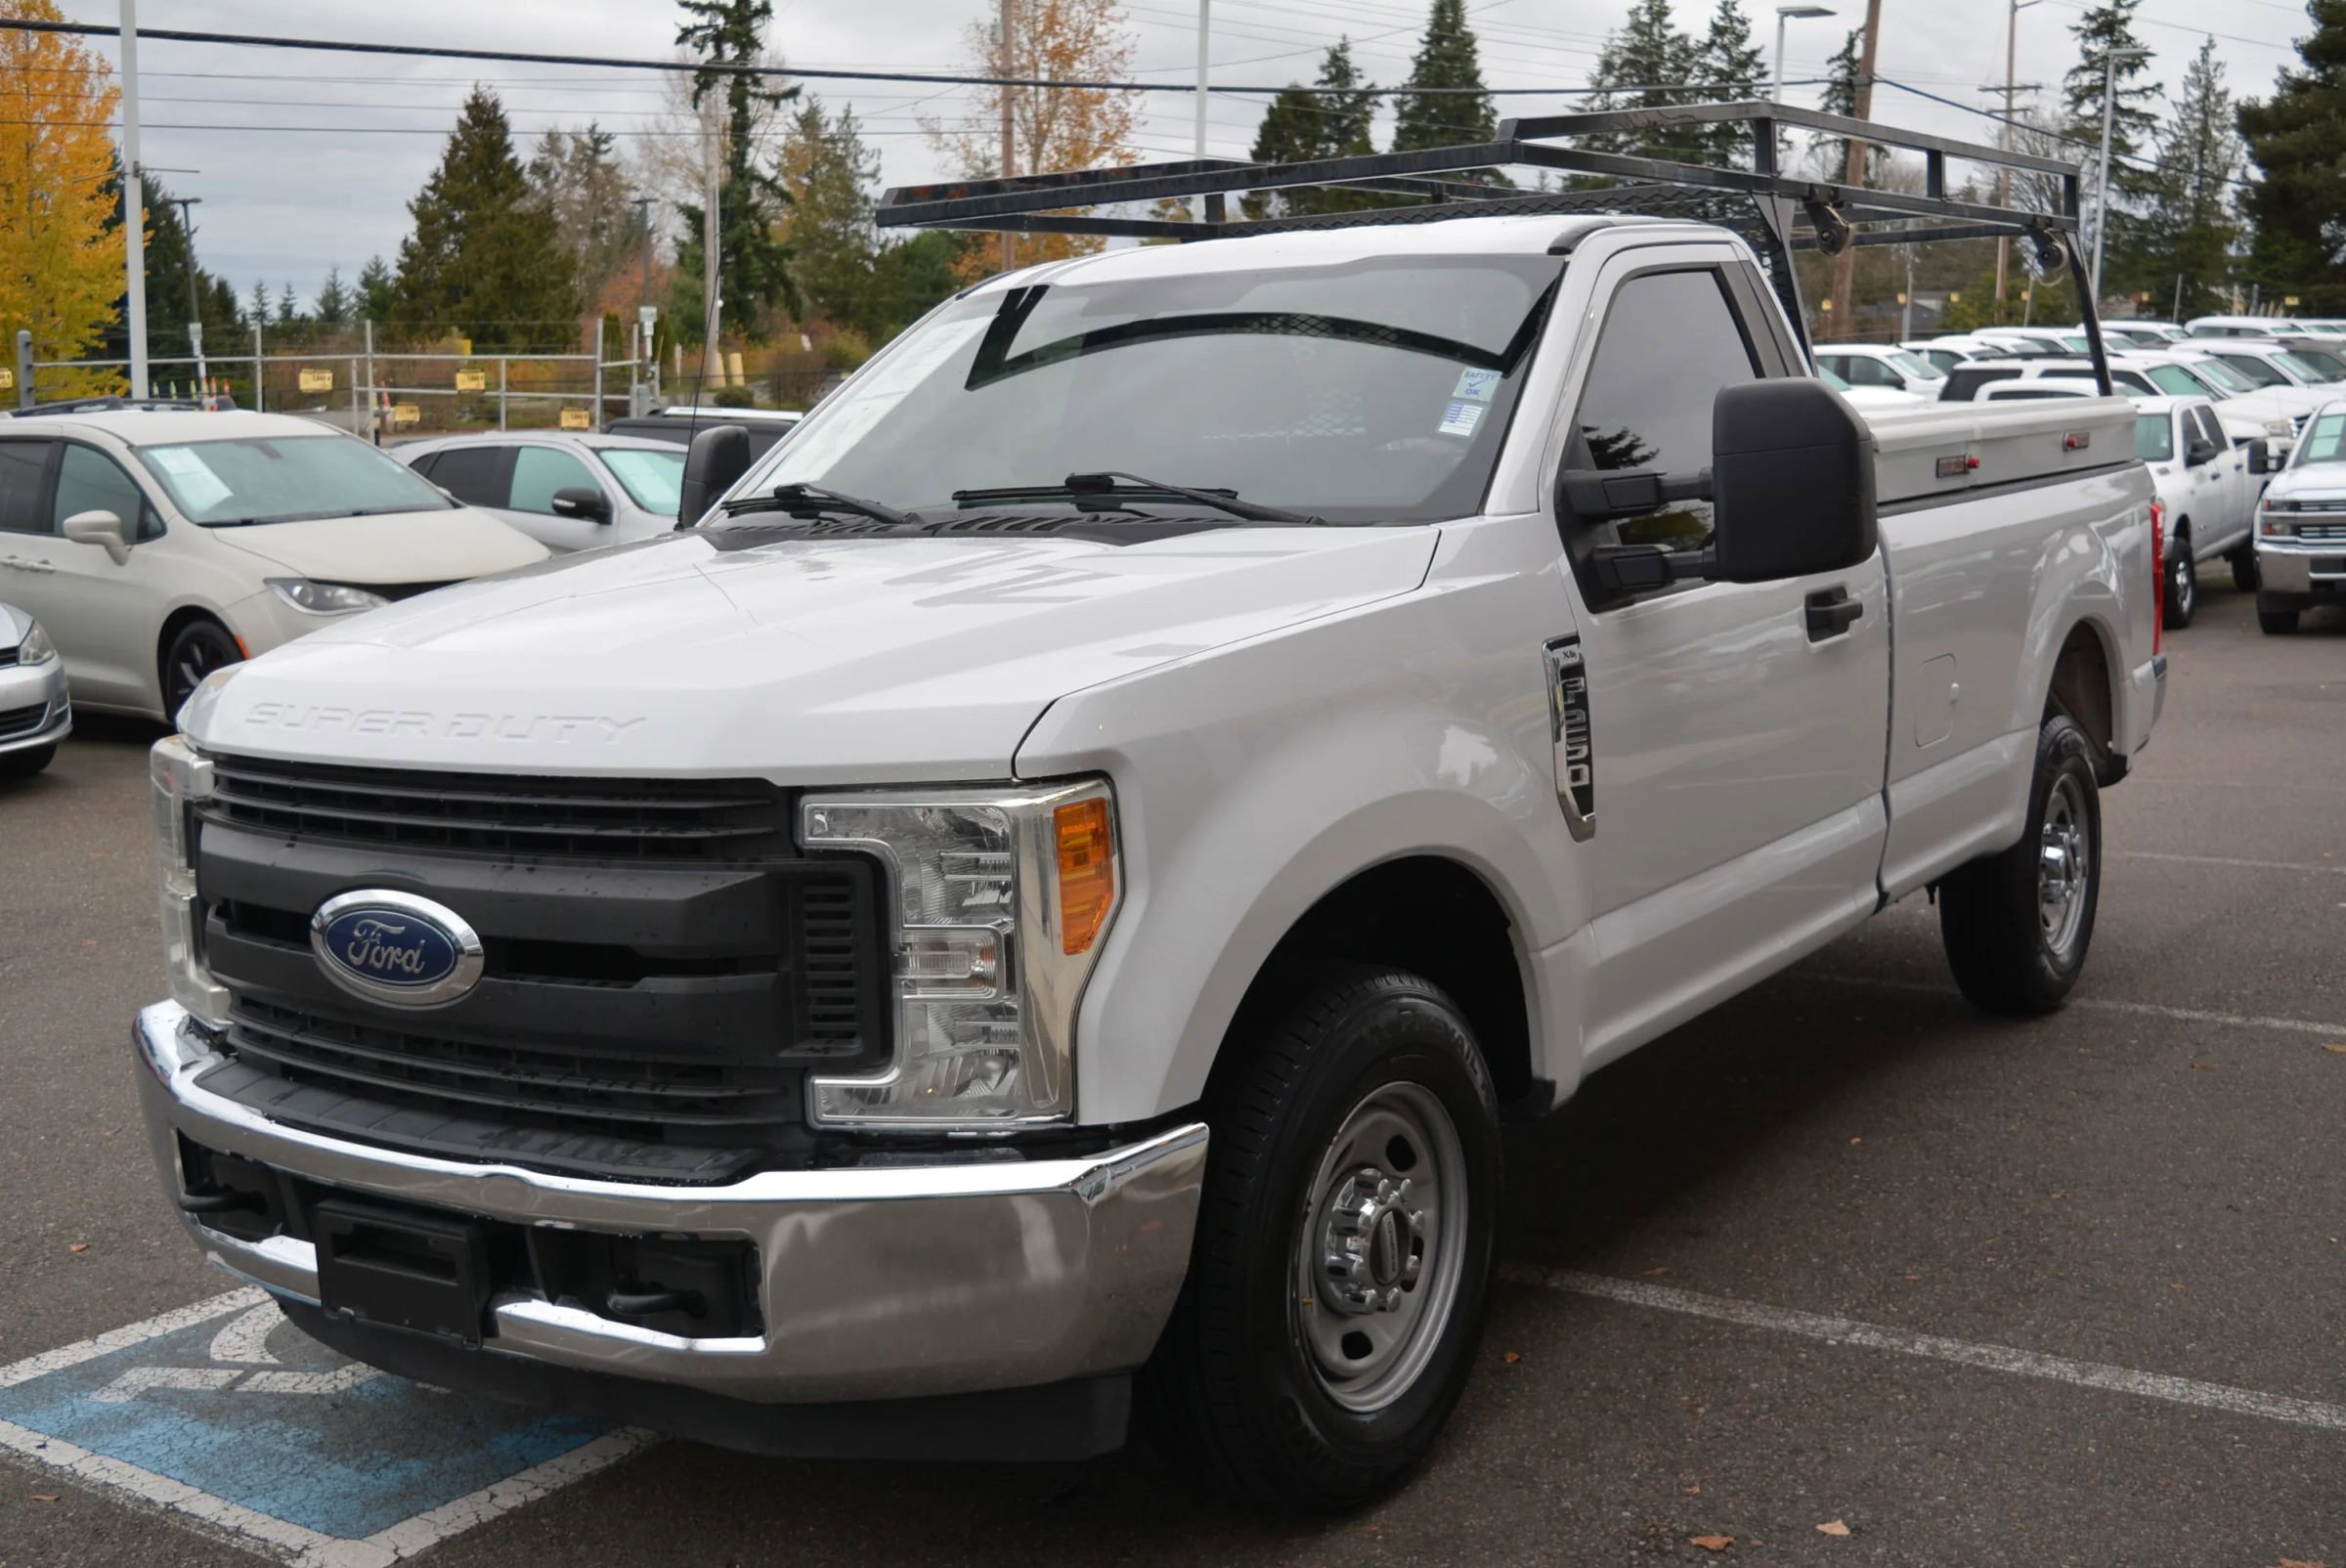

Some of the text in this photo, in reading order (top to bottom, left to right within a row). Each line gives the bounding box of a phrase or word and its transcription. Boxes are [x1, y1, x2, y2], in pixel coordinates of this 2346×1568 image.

[1464, 371, 1497, 380] SAFETY
[245, 701, 648, 746] SUPER DUTY
[347, 919, 426, 975] Ford
